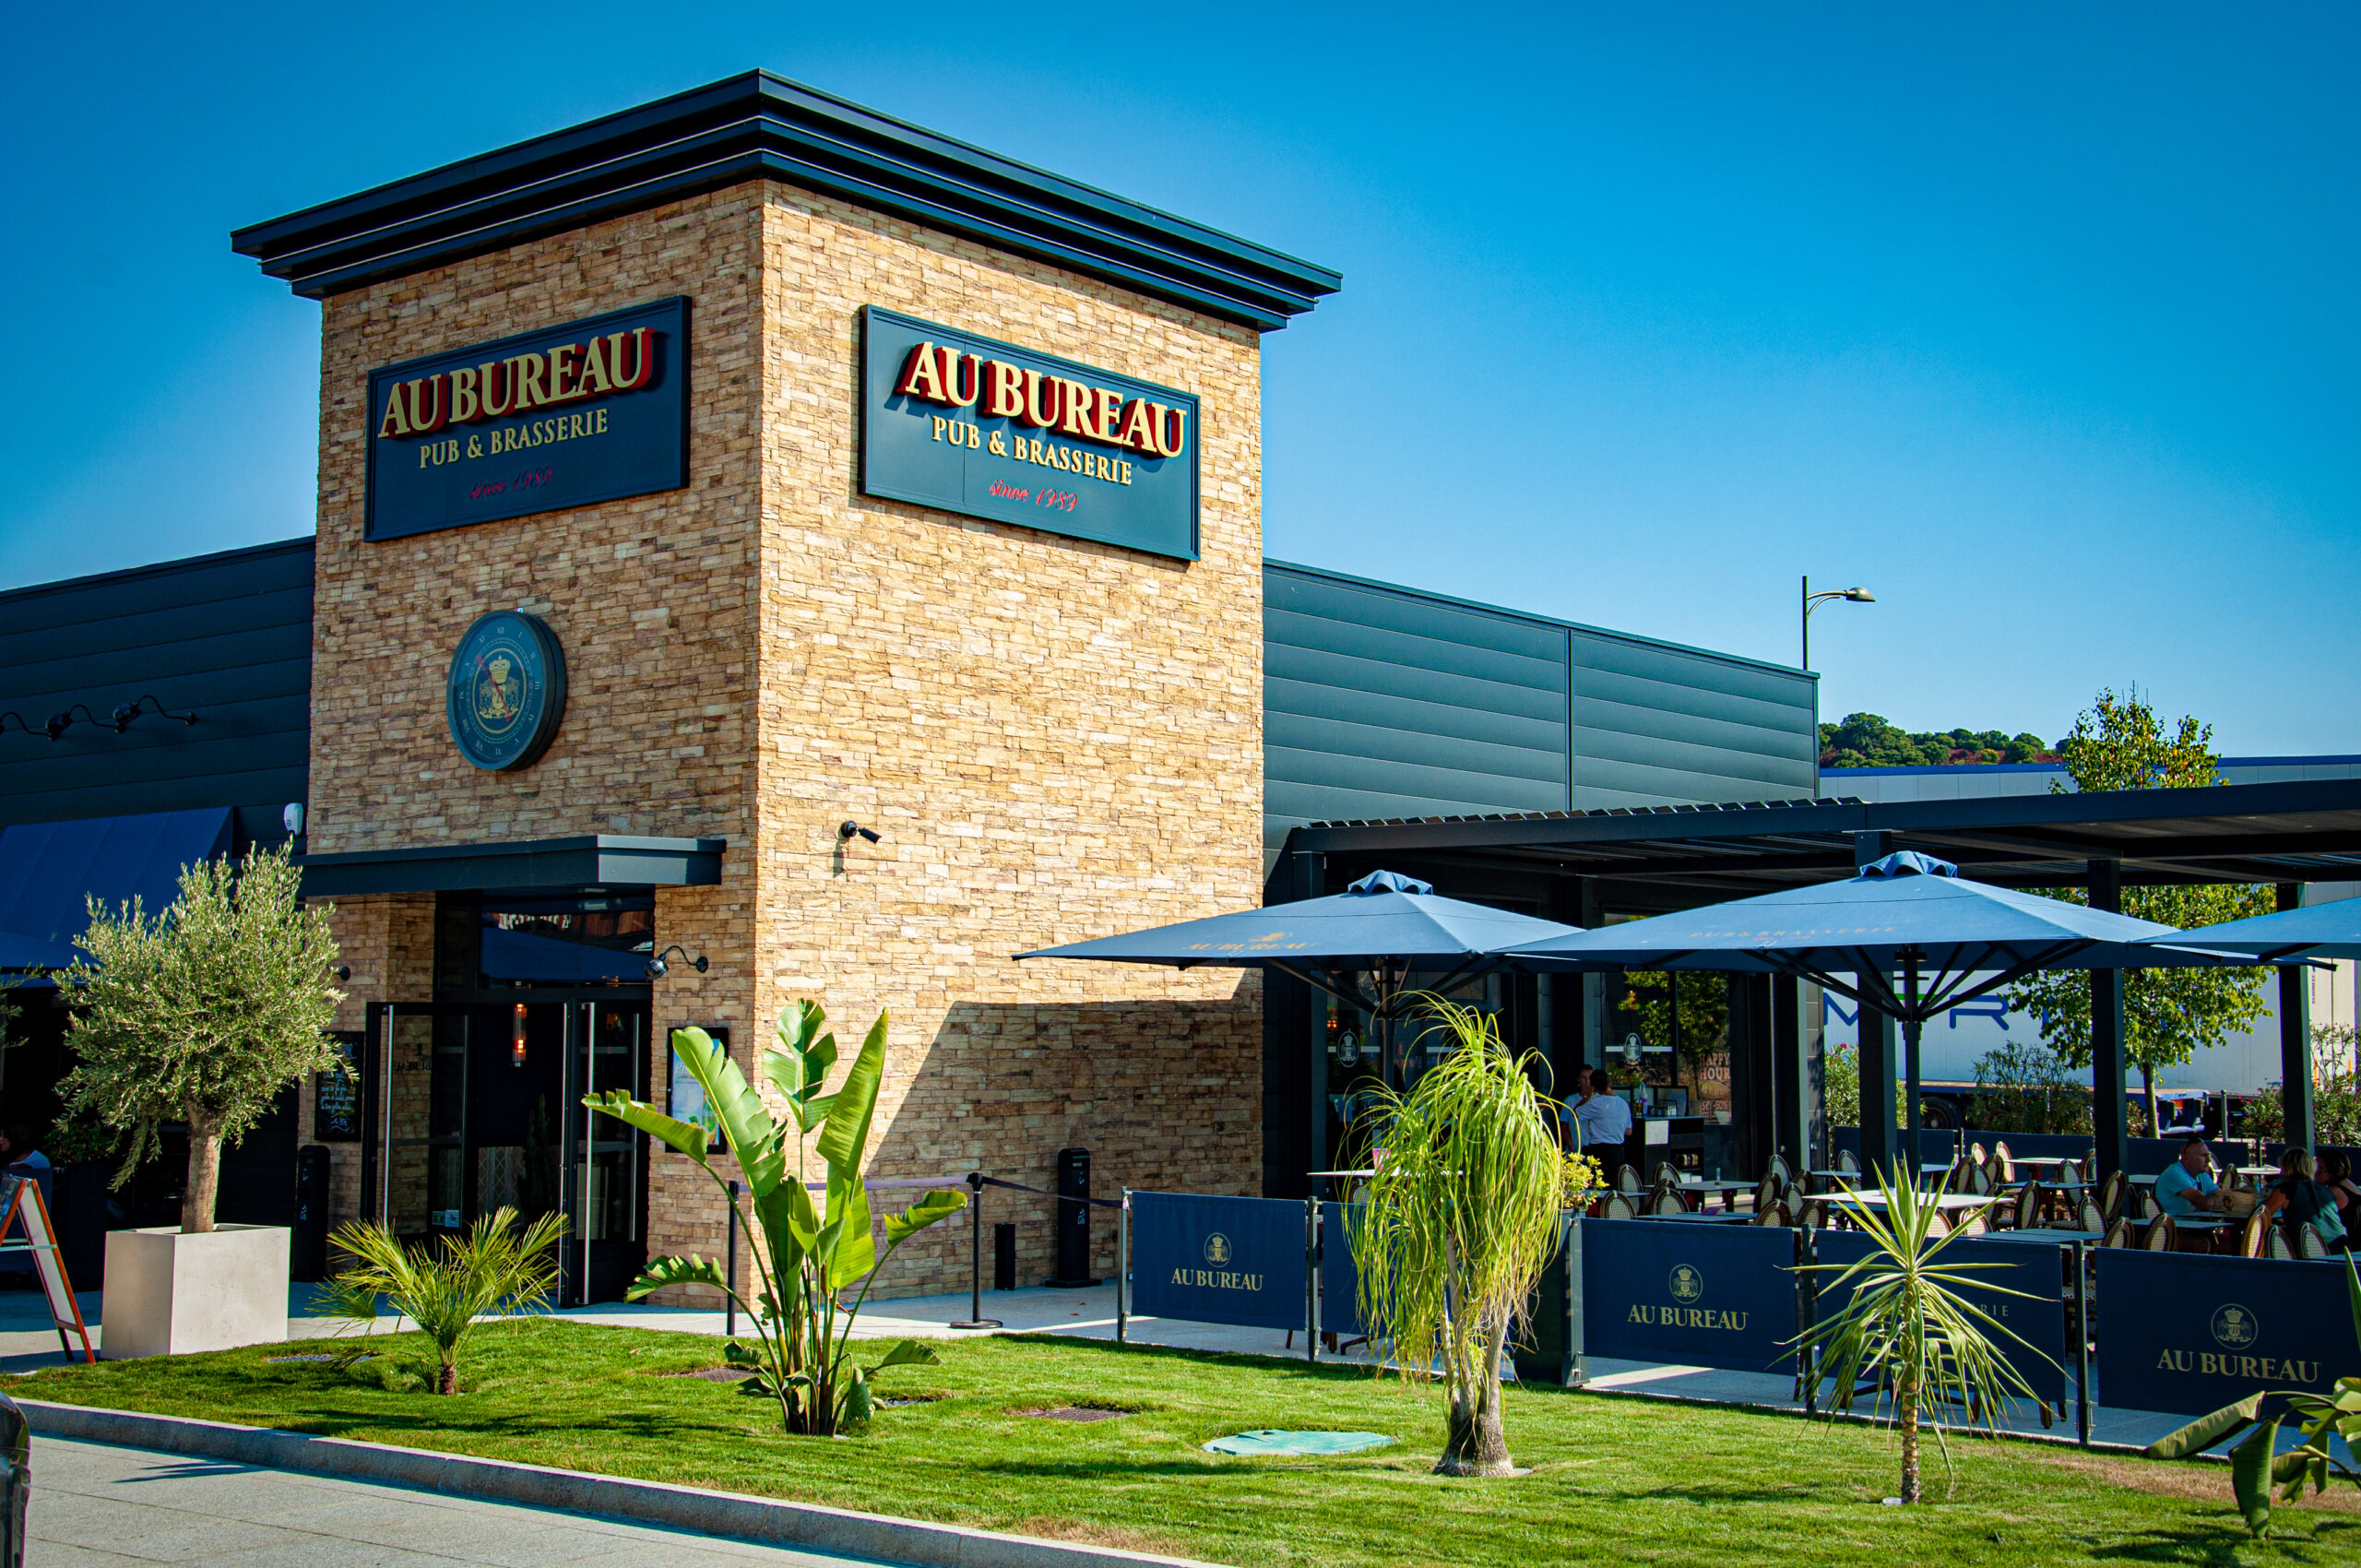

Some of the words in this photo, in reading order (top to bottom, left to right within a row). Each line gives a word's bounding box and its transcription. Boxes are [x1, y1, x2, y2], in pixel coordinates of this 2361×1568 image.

[377, 373, 448, 438] AU
[448, 327, 656, 425] BUREAU
[897, 340, 983, 408] AU
[984, 359, 1187, 458] BUREAU
[419, 439, 459, 469] PUB
[467, 434, 484, 458] &
[491, 408, 609, 455] BRASSERIE
[931, 415, 981, 450] PUB
[988, 430, 1008, 457] &
[1014, 434, 1133, 486] BRASSERIE
[512, 465, 553, 493] 1989
[989, 478, 1030, 503] since
[1036, 487, 1079, 512] 1989
[1699, 1052, 1730, 1066] HAPPY
[1699, 1067, 1731, 1080] HOUR
[1170, 1267, 1194, 1286] AU
[1196, 1269, 1263, 1291] BUREAU
[1627, 1304, 1655, 1324] AU
[1659, 1306, 1748, 1331] BUREAU
[2156, 1348, 2194, 1372] AU
[2200, 1352, 2319, 1384] BUREAU
